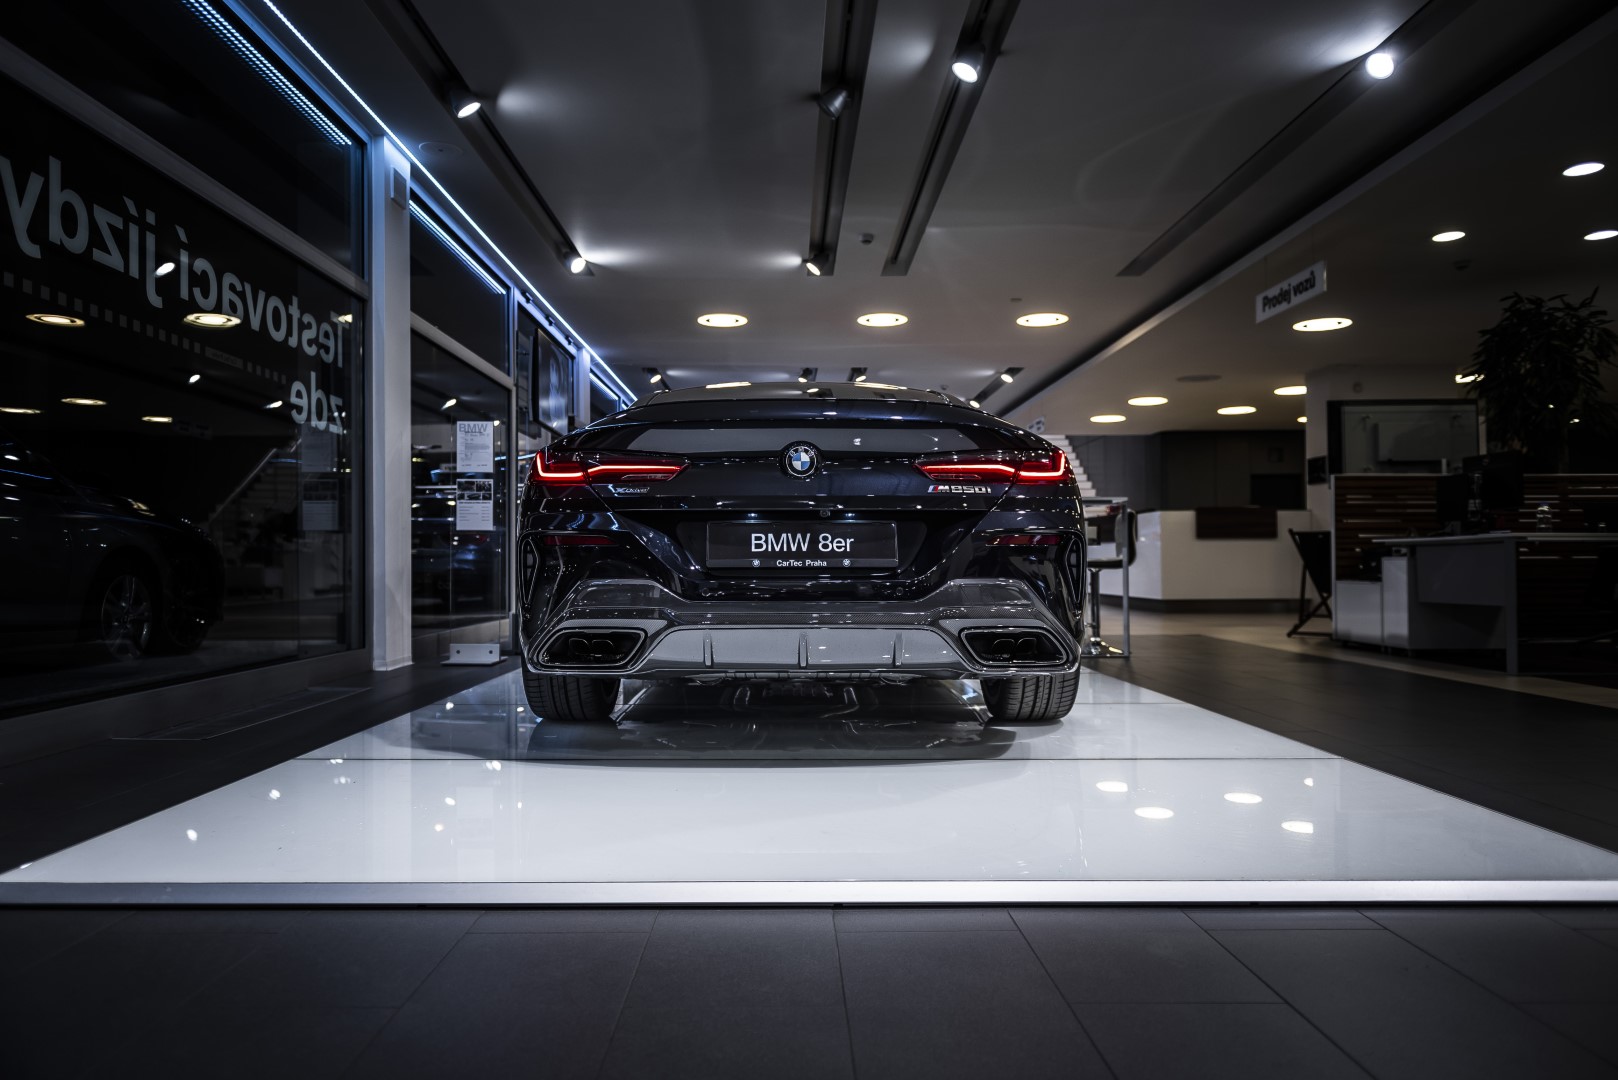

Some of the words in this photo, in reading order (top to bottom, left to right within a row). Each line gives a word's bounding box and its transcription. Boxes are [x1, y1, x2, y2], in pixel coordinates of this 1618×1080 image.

[1262, 283, 1292, 313] Prodej
[1293, 270, 1316, 297] vozů
[459, 423, 488, 433] BMW
[751, 533, 810, 552] BMW
[818, 533, 855, 552] 8er
[776, 559, 803, 567] CarTec
[805, 559, 827, 567] Praha
